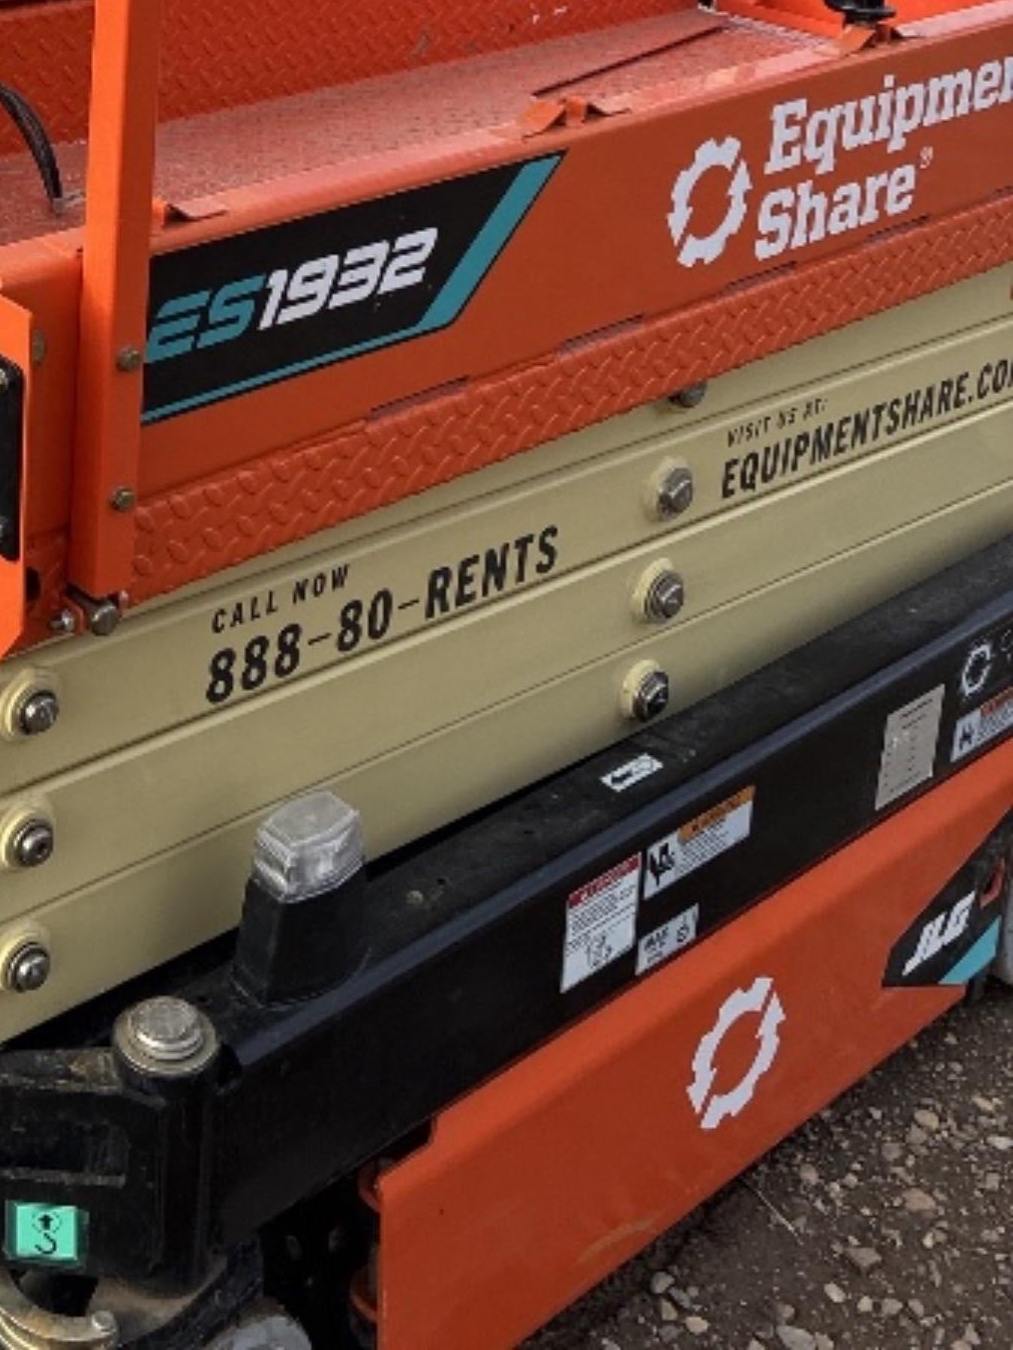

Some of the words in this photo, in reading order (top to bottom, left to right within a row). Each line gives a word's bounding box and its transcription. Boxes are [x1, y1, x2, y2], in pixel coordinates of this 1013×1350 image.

[145, 227, 438, 363] ES1932
[721, 359, 1013, 499] EQUIPMENTSHARE.CO
[205, 524, 559, 705] 888-80-RENTS
[211, 589, 279, 634] CALL
[291, 563, 350, 606] NOW
